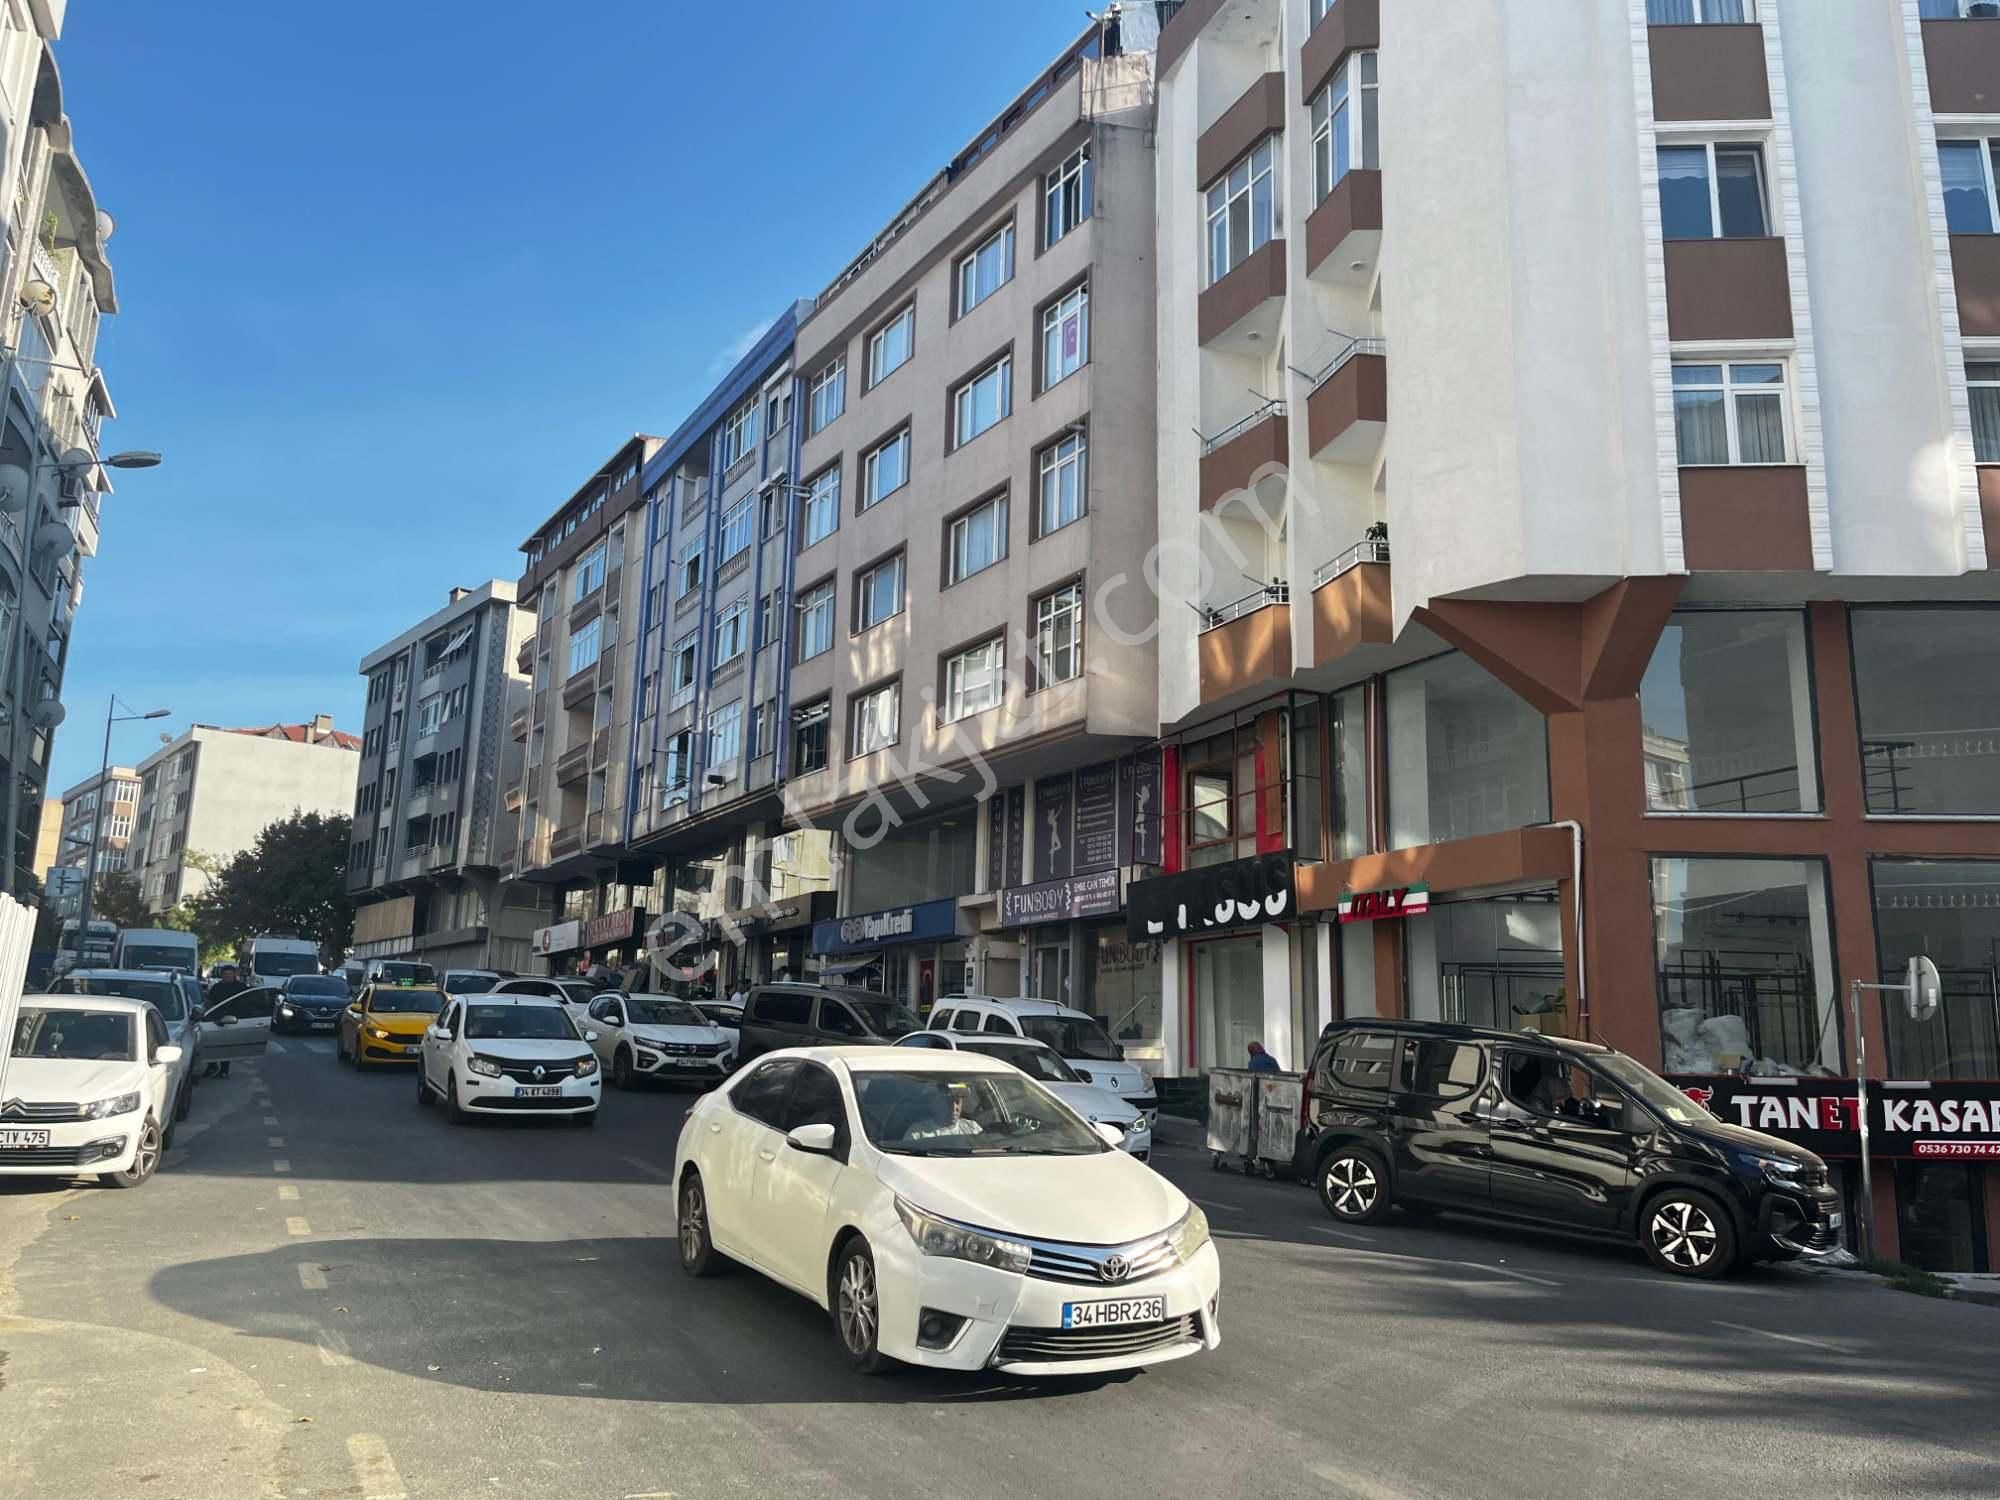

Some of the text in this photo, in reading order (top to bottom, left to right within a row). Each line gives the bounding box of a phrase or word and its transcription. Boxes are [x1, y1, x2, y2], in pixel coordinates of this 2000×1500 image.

[1013, 888, 1064, 914] FUNBODY
[1350, 887, 1410, 917] ITALY
[24, 1132, 46, 1144] 475
[1918, 1144, 1948, 1154] 0536
[1950, 1144, 1971, 1154] 730
[1973, 1144, 1986, 1154] 74
